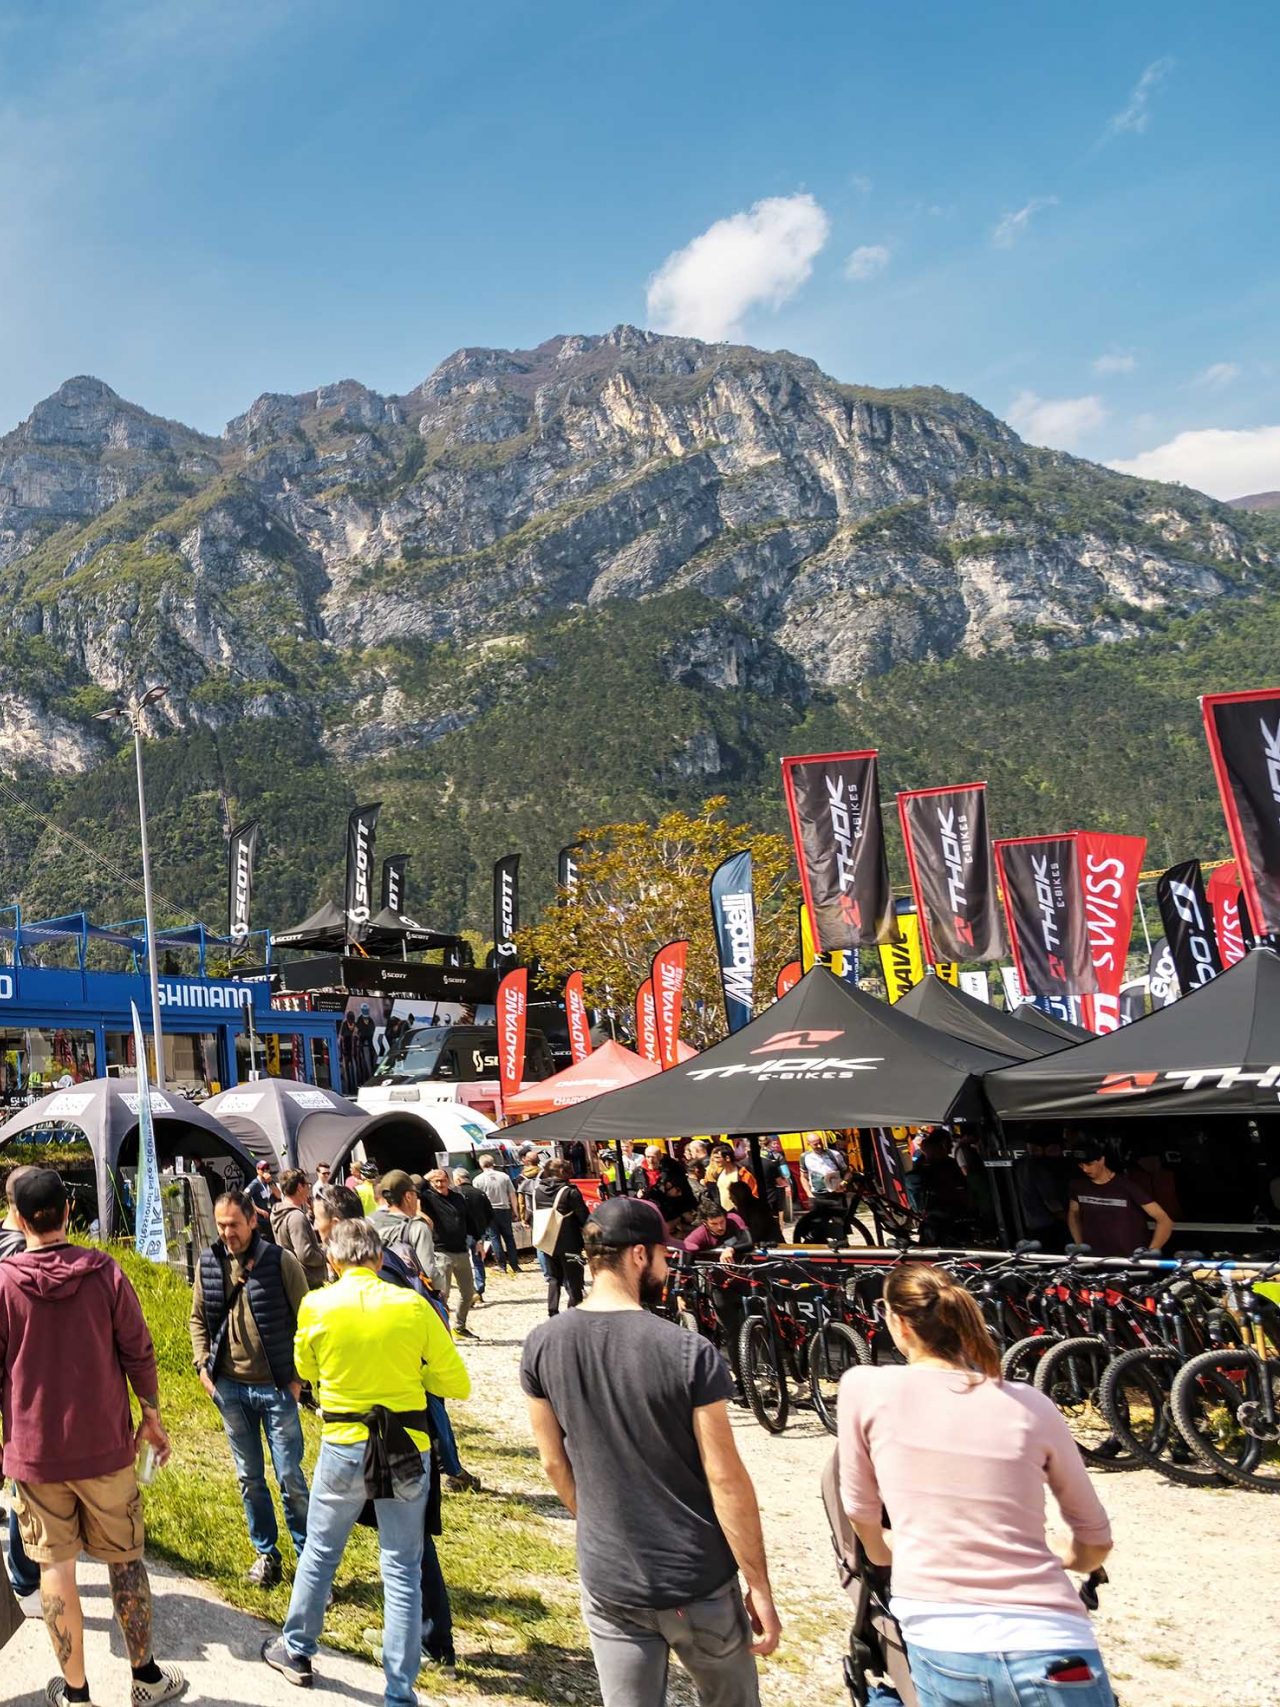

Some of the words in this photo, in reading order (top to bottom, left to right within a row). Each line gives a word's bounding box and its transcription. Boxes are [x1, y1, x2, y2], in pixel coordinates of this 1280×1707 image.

[355, 819, 369, 906] SCOTT
[825, 775, 855, 891] THOK
[937, 807, 967, 912] THOK
[236, 839, 248, 921] SCOTT
[388, 867, 399, 911] OTT
[502, 870, 513, 938] SCOTT
[1031, 855, 1060, 951] THOK
[158, 984, 252, 1008] SHIMANO
[570, 988, 587, 1065] HAOYANG
[643, 993, 657, 1062] HAOYANG
[505, 988, 518, 1080] CHAOYANG
[686, 1057, 885, 1081] THOK
[757, 1070, 855, 1081] E-BIKES
[1165, 1066, 1280, 1090] TH
